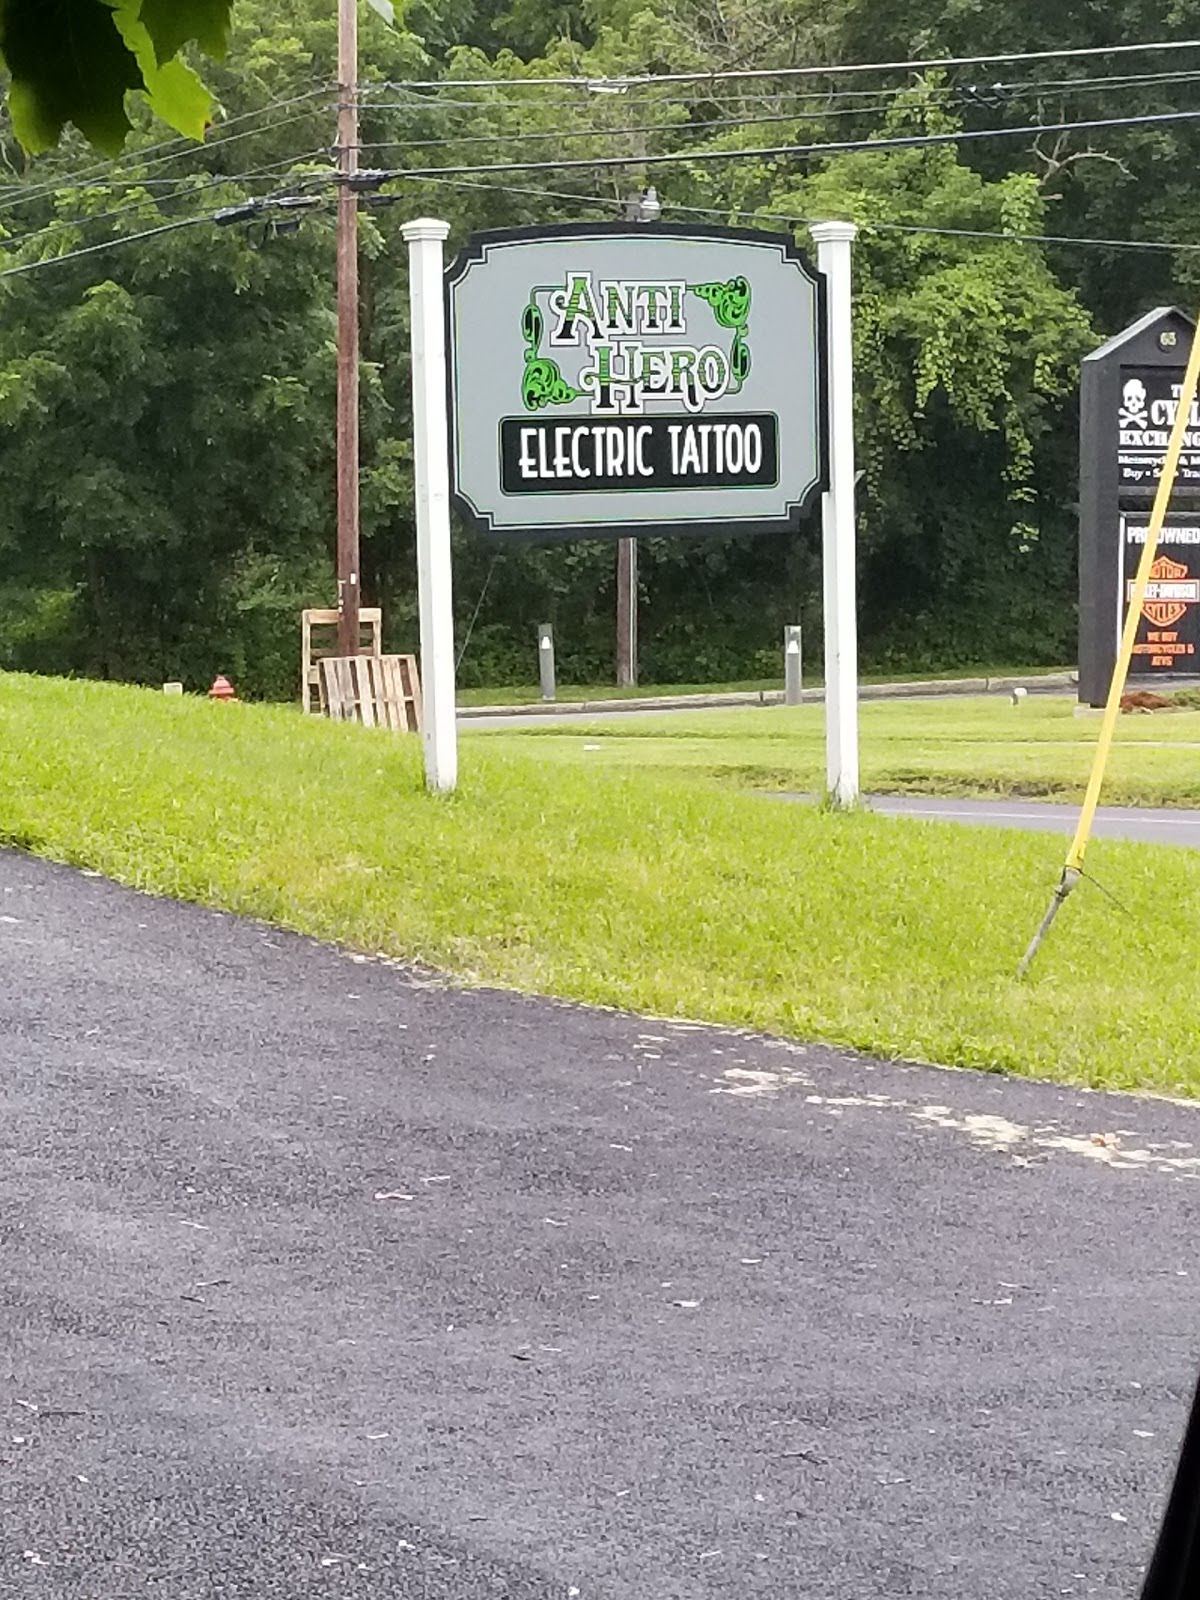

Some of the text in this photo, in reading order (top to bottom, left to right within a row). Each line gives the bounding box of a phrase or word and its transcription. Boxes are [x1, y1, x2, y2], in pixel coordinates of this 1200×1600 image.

[549, 271, 687, 347] ANTI
[579, 340, 729, 414] HERO
[1119, 430, 1200, 447] EXCHNG
[1151, 400, 1200, 427] CYL
[518, 423, 763, 479] ELECTRIC TATTOO
